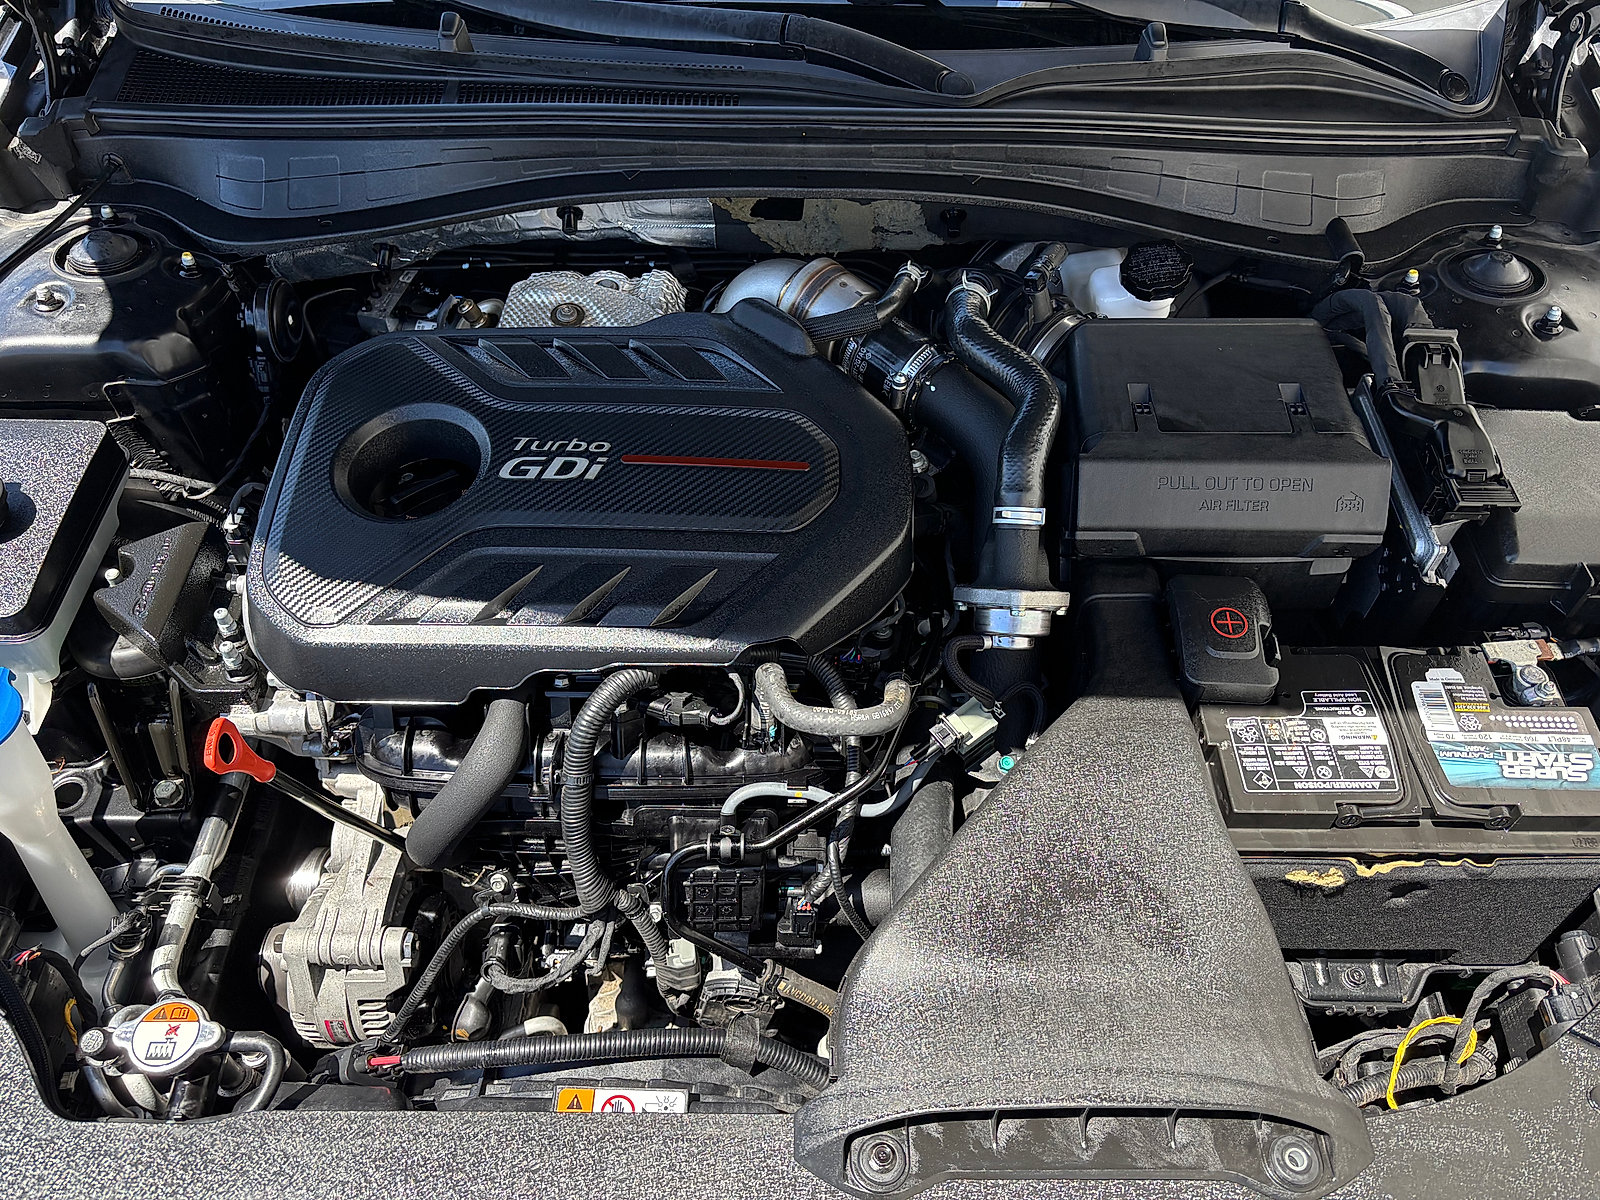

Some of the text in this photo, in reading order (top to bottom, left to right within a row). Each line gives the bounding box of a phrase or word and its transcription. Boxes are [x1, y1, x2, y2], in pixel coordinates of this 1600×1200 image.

[513, 436, 612, 453] Turbo
[498, 456, 610, 480] GDi
[1157, 475, 1315, 492] PULL OUT TO OPEN
[1198, 500, 1270, 512] AIR FILTER
[1439, 750, 1494, 759] PLATINUM
[1499, 752, 1594, 771] START
[1502, 765, 1588, 782] SUPER
